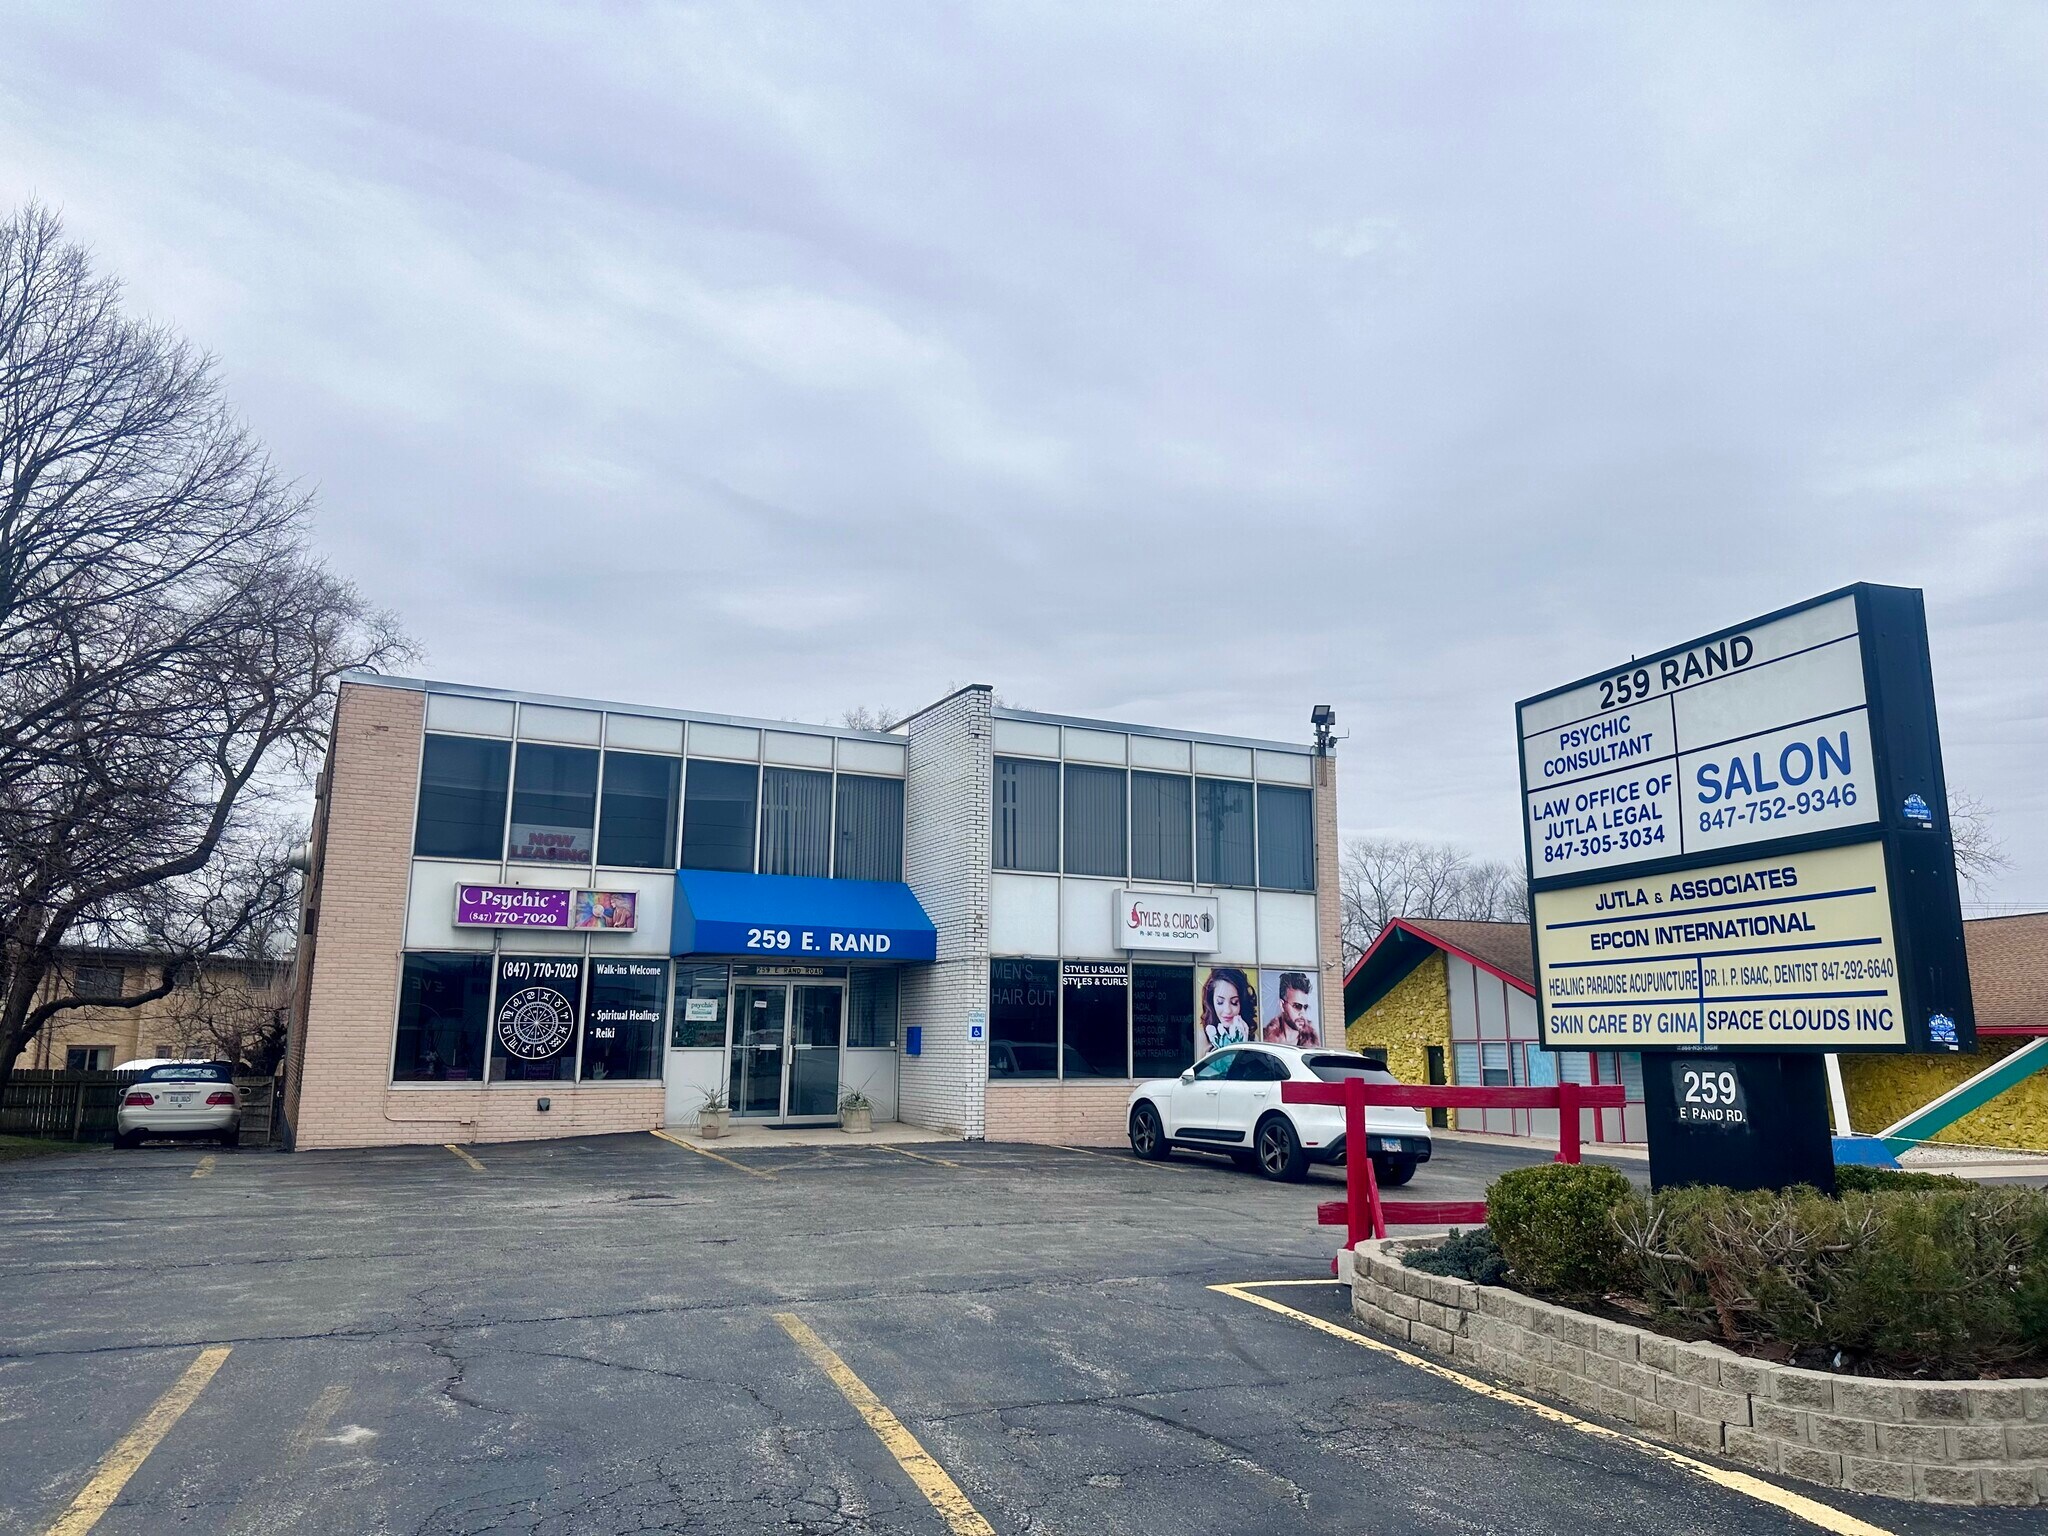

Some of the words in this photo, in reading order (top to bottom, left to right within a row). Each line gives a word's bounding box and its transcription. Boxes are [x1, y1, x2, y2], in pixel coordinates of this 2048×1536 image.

[1600, 669, 1650, 710] 259
[1660, 636, 1753, 690] RAND
[1560, 715, 1631, 750] PSYCHIC
[1544, 733, 1653, 777] CONSULTANT
[1697, 731, 1851, 804] SALON
[1533, 797, 1570, 821] LAW
[1575, 781, 1640, 812] OFFICE
[1646, 774, 1672, 796] OF
[1699, 783, 1857, 832] 847-752-9346
[1545, 814, 1598, 841] JUTLA
[1602, 801, 1662, 829] LEGAL
[528, 832, 576, 848] NOW
[1544, 824, 1665, 862] 847-305-3034
[510, 845, 590, 863] LEASING
[1595, 888, 1649, 911] JUTLA
[1654, 892, 1664, 904] &
[1670, 866, 1798, 902] ASSOCIATES
[480, 890, 550, 910] Psychic
[469, 911, 492, 922] (847)
[494, 912, 557, 924] 770-7020
[1163, 913, 1170, 928] &
[1172, 913, 1199, 929] CURLS
[747, 928, 791, 950] 259
[801, 932, 820, 950] E.
[830, 933, 891, 952] RAND
[1172, 931, 1199, 939] salon
[1590, 928, 1650, 950] EPCON
[1654, 911, 1816, 945] INTERNATIONAL
[502, 962, 530, 980] (847)
[533, 963, 579, 979] 770-7020
[596, 964, 627, 975] Walk-ins
[629, 964, 661, 976] Welcome
[805, 967, 824, 975] ROAD
[992, 962, 1033, 980] MEN'S
[1064, 965, 1090, 973] STYLE
[1091, 965, 1098, 973] U
[1099, 965, 1126, 974] SALON
[1704, 969, 1720, 987] DR.
[1722, 968, 1728, 986] I.
[1731, 968, 1739, 986] P.
[1740, 965, 1772, 987] ISAAC,
[1774, 962, 1818, 984] DENTIST
[1822, 957, 1894, 982] 847-292-6640
[1062, 977, 1093, 987] STYLES
[1094, 977, 1100, 986] &
[1101, 977, 1128, 986] CURLS
[1549, 977, 1585, 997] HEALING
[1586, 974, 1628, 995] PARADISE
[1629, 969, 1698, 993] ACUPUNCTURE
[991, 988, 1024, 1006] HAIR
[1027, 988, 1054, 1006] CUT
[596, 1010, 628, 1021] Spiritual
[629, 1010, 660, 1021] Healings
[1551, 1014, 1584, 1034] SKIN
[1588, 1014, 1628, 1034] CARE
[1632, 1013, 1653, 1033] BY
[1657, 1012, 1698, 1033] GINA
[1707, 1009, 1764, 1031] SPACE
[1769, 1009, 1850, 1031] CLOUDS
[1857, 1008, 1894, 1031] INC
[595, 1028, 615, 1039] Reiki
[1684, 1071, 1736, 1105] 259
[1680, 1107, 1687, 1118] E
[1726, 1109, 1747, 1122] RD.
